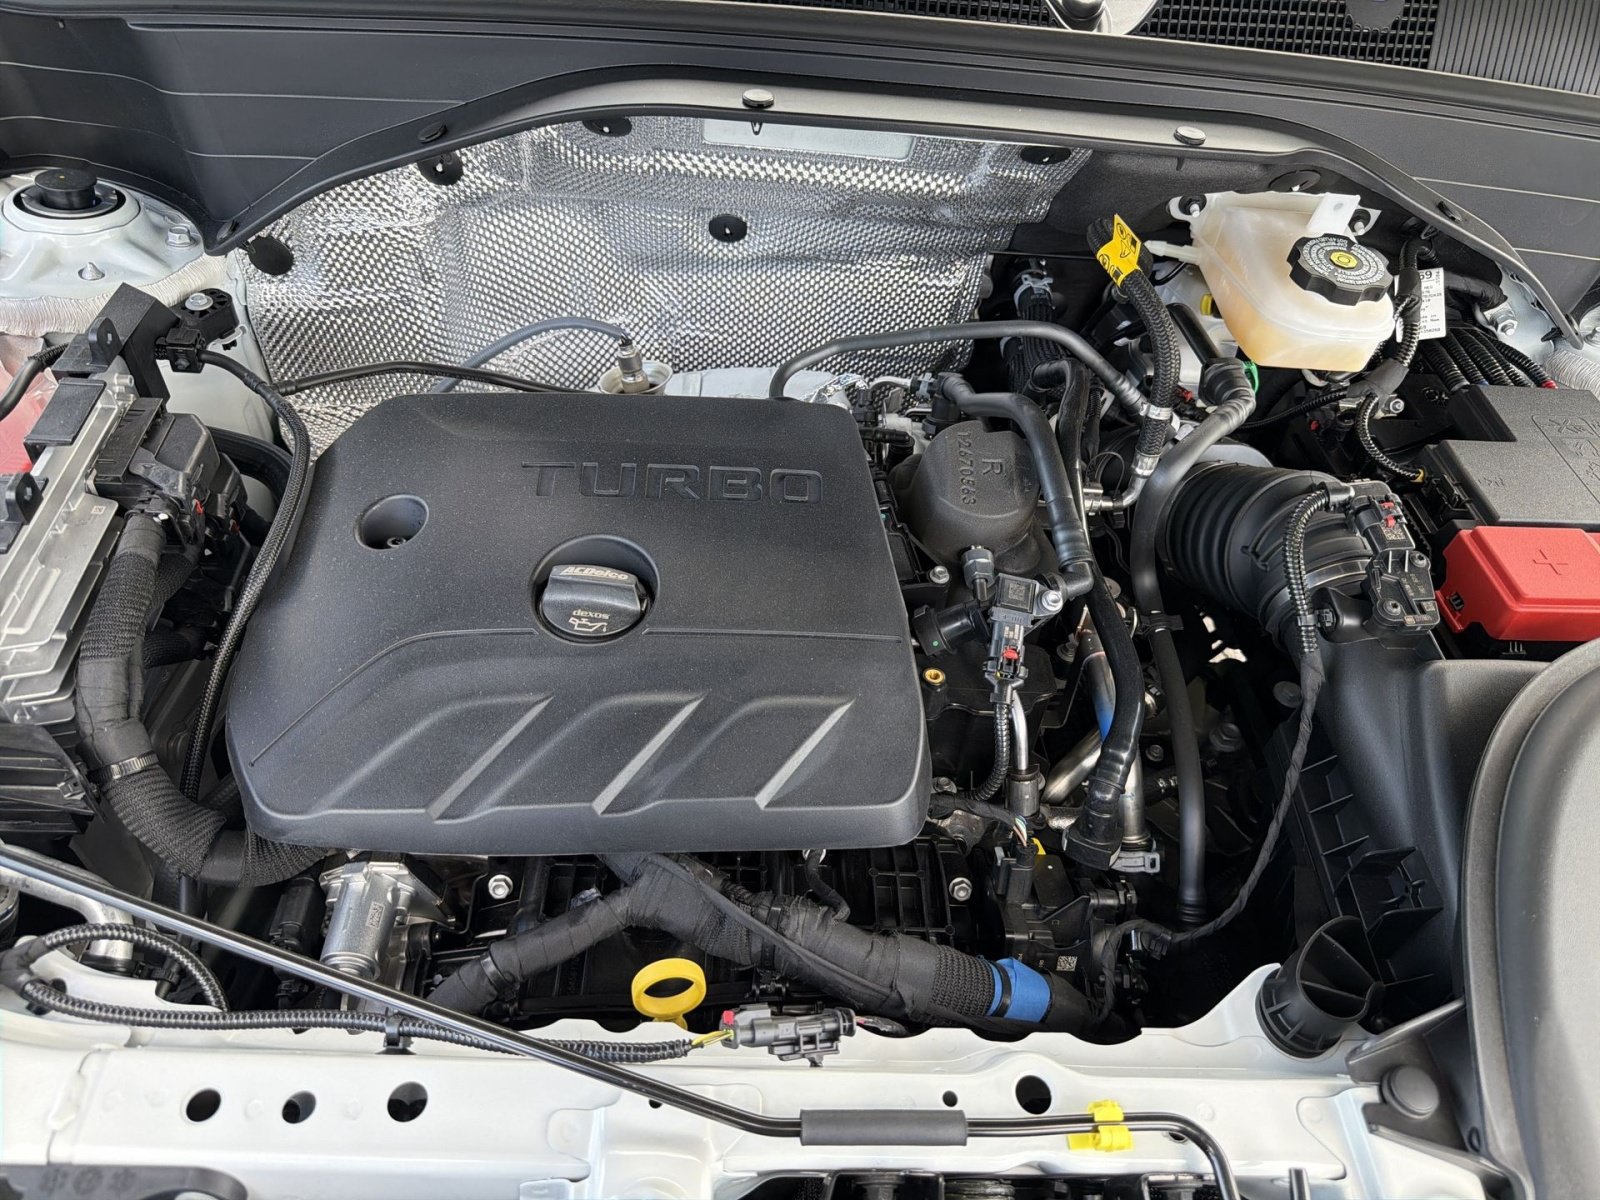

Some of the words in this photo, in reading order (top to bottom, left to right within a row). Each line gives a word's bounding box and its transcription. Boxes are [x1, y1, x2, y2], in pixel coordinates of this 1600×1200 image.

[957, 431, 977, 505] 12670563
[982, 458, 1003, 476] R
[521, 461, 824, 501] TURBO
[560, 566, 629, 580] ACDelco
[572, 608, 611, 620] dexos
